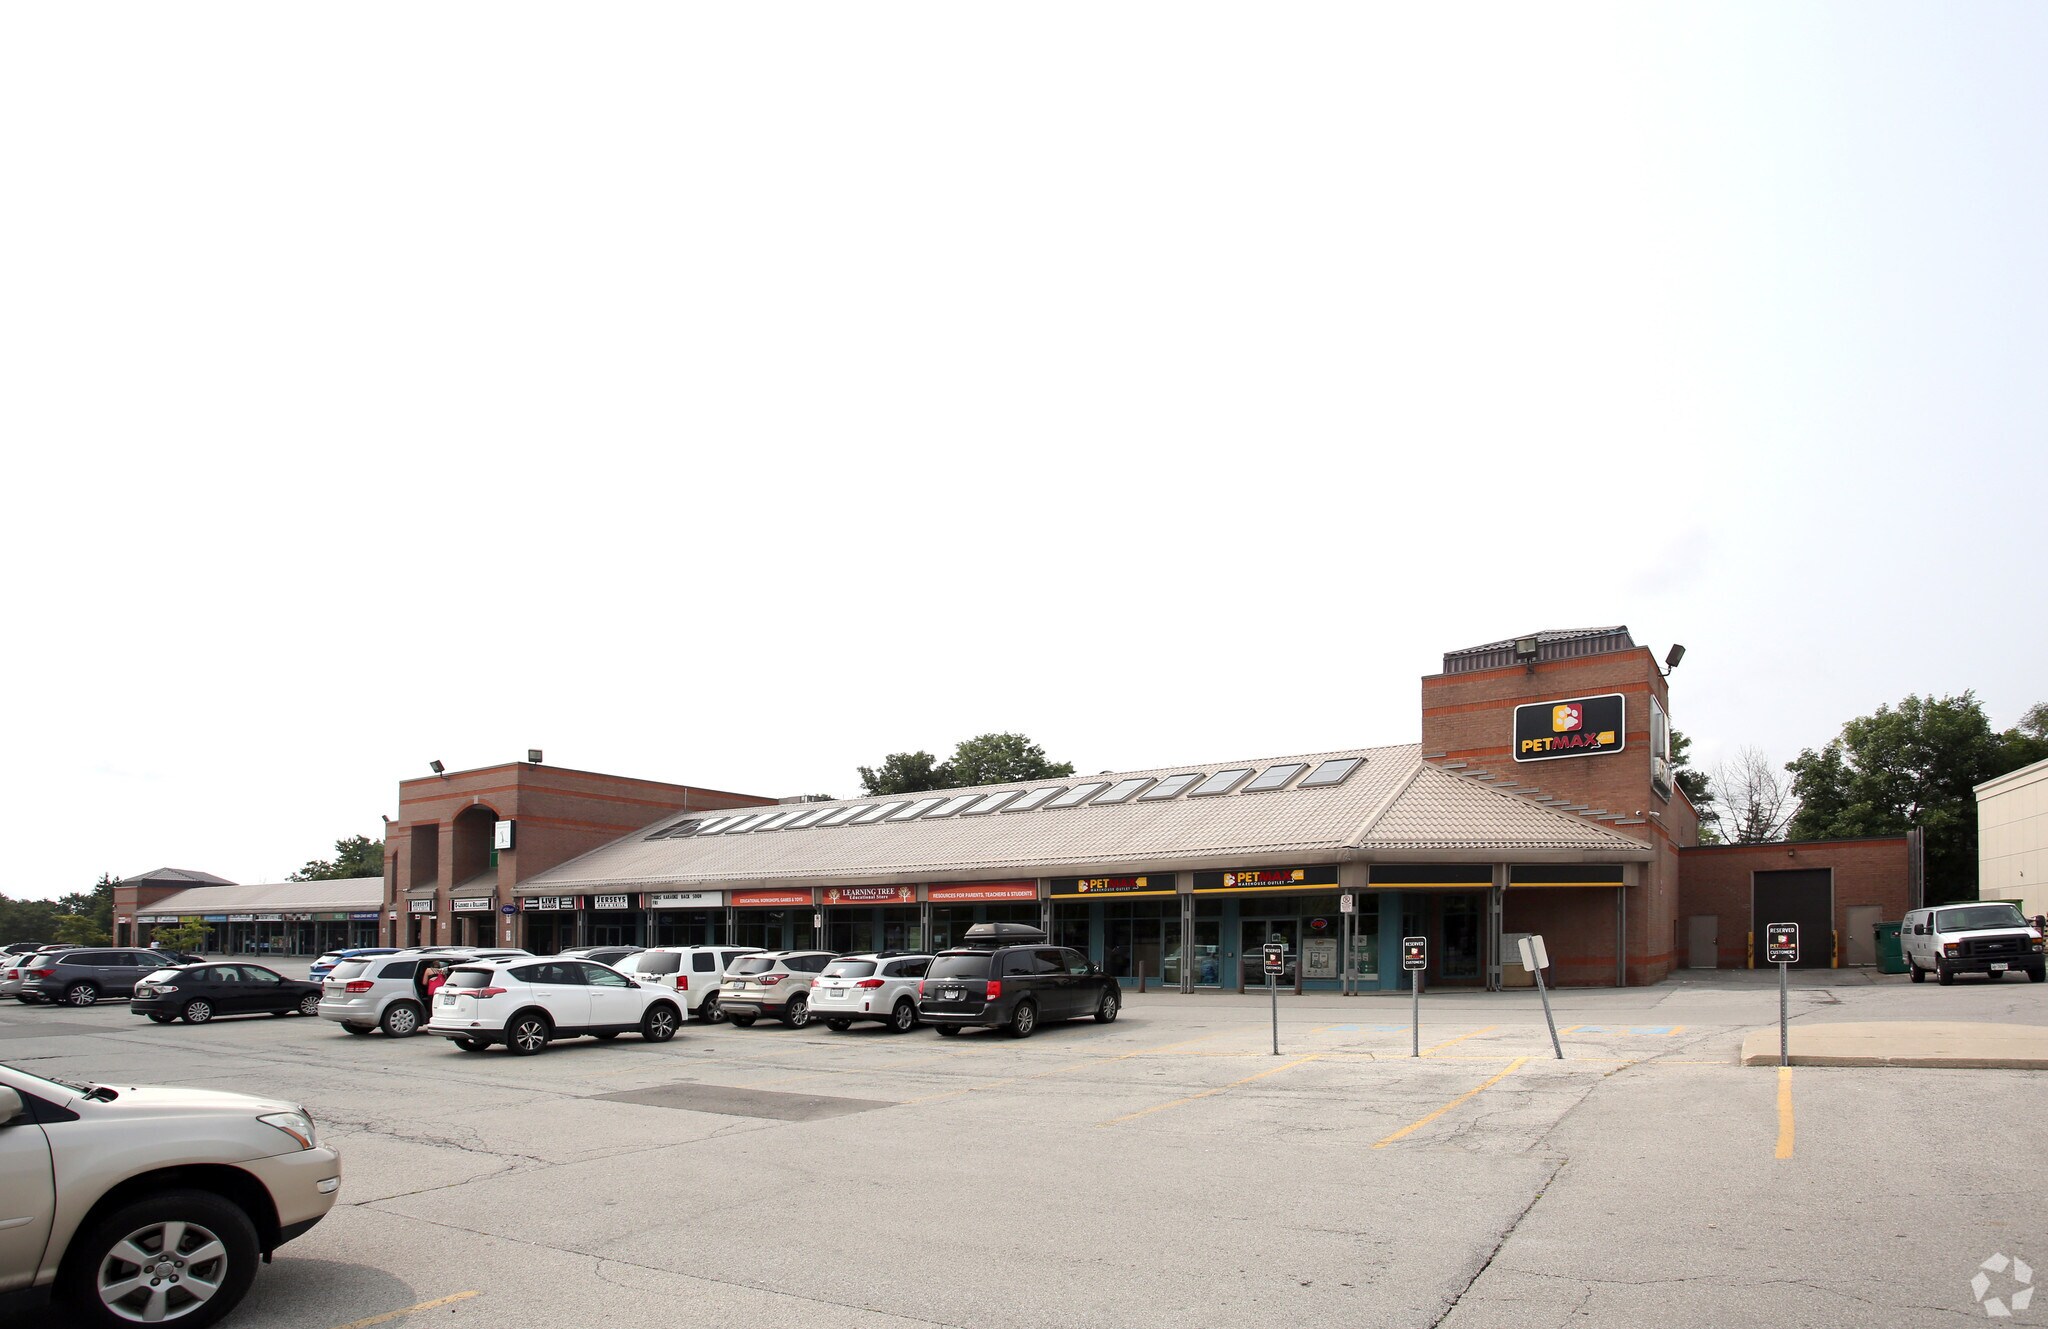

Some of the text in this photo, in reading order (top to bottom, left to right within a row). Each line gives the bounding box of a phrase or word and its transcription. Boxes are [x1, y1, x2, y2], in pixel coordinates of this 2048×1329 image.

[1521, 732, 1597, 753] PETMAX
[1237, 870, 1292, 883] PETMAX
[1089, 877, 1136, 889] PETMAX
[842, 887, 895, 896] LEARNING TREE
